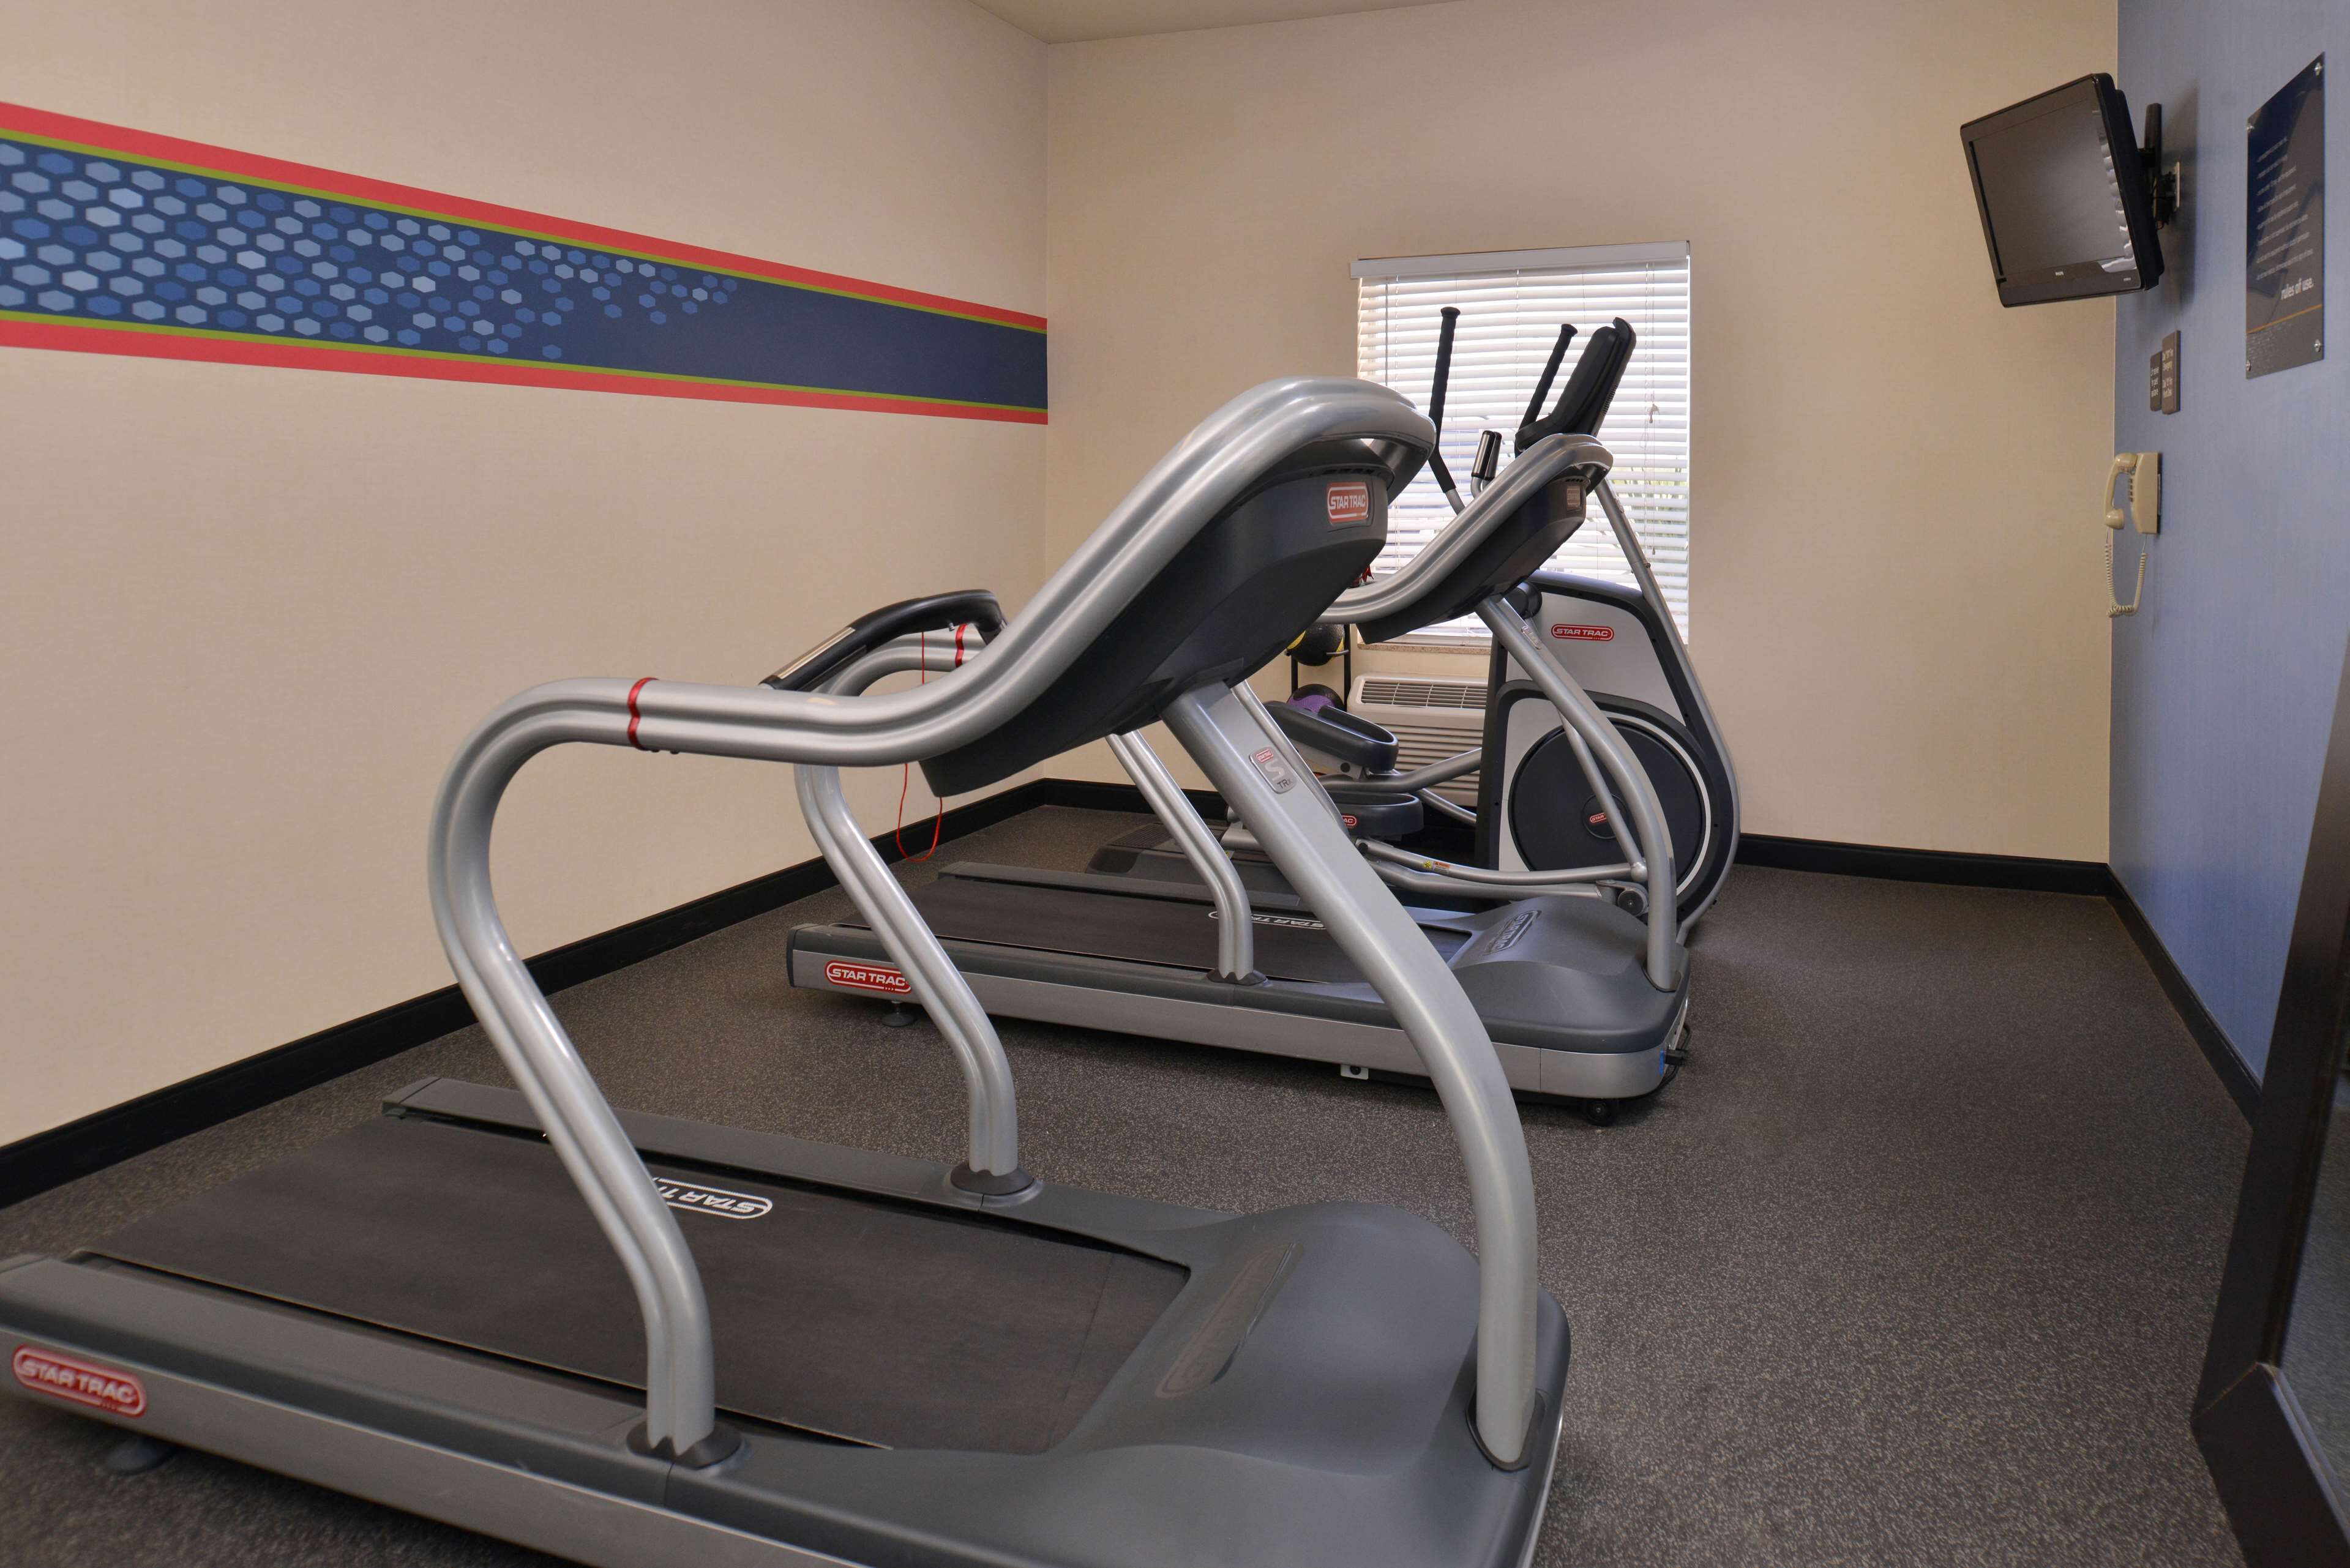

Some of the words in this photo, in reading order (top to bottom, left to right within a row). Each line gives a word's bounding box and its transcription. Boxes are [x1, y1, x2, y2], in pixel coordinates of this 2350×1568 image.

[2280, 284, 2294, 300] rules
[2295, 278, 2302, 294] of
[1329, 495, 1349, 510] STAR
[1349, 494, 1366, 509] TRAC
[1274, 919, 1324, 928] STAR
[831, 968, 867, 982] STAR
[869, 973, 906, 987] TRAC
[678, 1191, 763, 1214] STAR
[20, 1359, 75, 1389] STAR
[76, 1373, 135, 1404] TRAC
